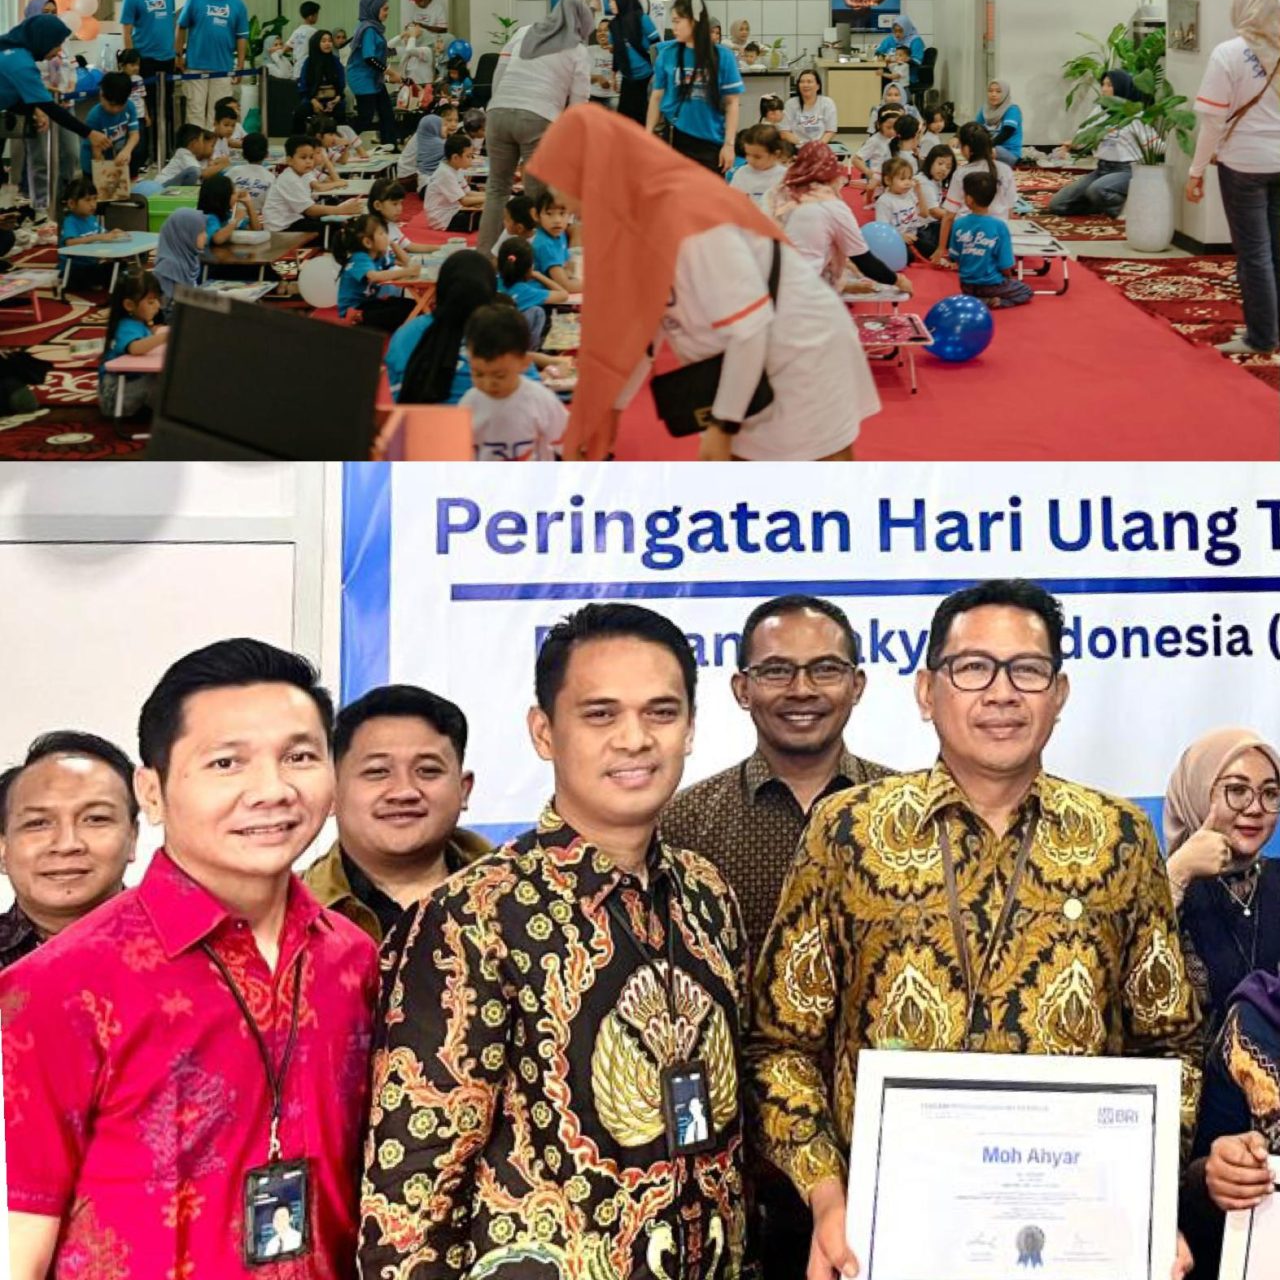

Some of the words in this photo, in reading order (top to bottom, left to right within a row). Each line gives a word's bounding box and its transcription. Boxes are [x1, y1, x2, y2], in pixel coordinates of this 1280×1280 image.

[436, 494, 851, 571] Peringatan
[879, 494, 1023, 554] Hari
[1048, 496, 1242, 567] Ulang
[1061, 613, 1253, 660] donesia
[1115, 1108, 1139, 1124] BRI
[982, 1145, 1022, 1165] Moh
[1027, 1146, 1081, 1169] Ahyar
